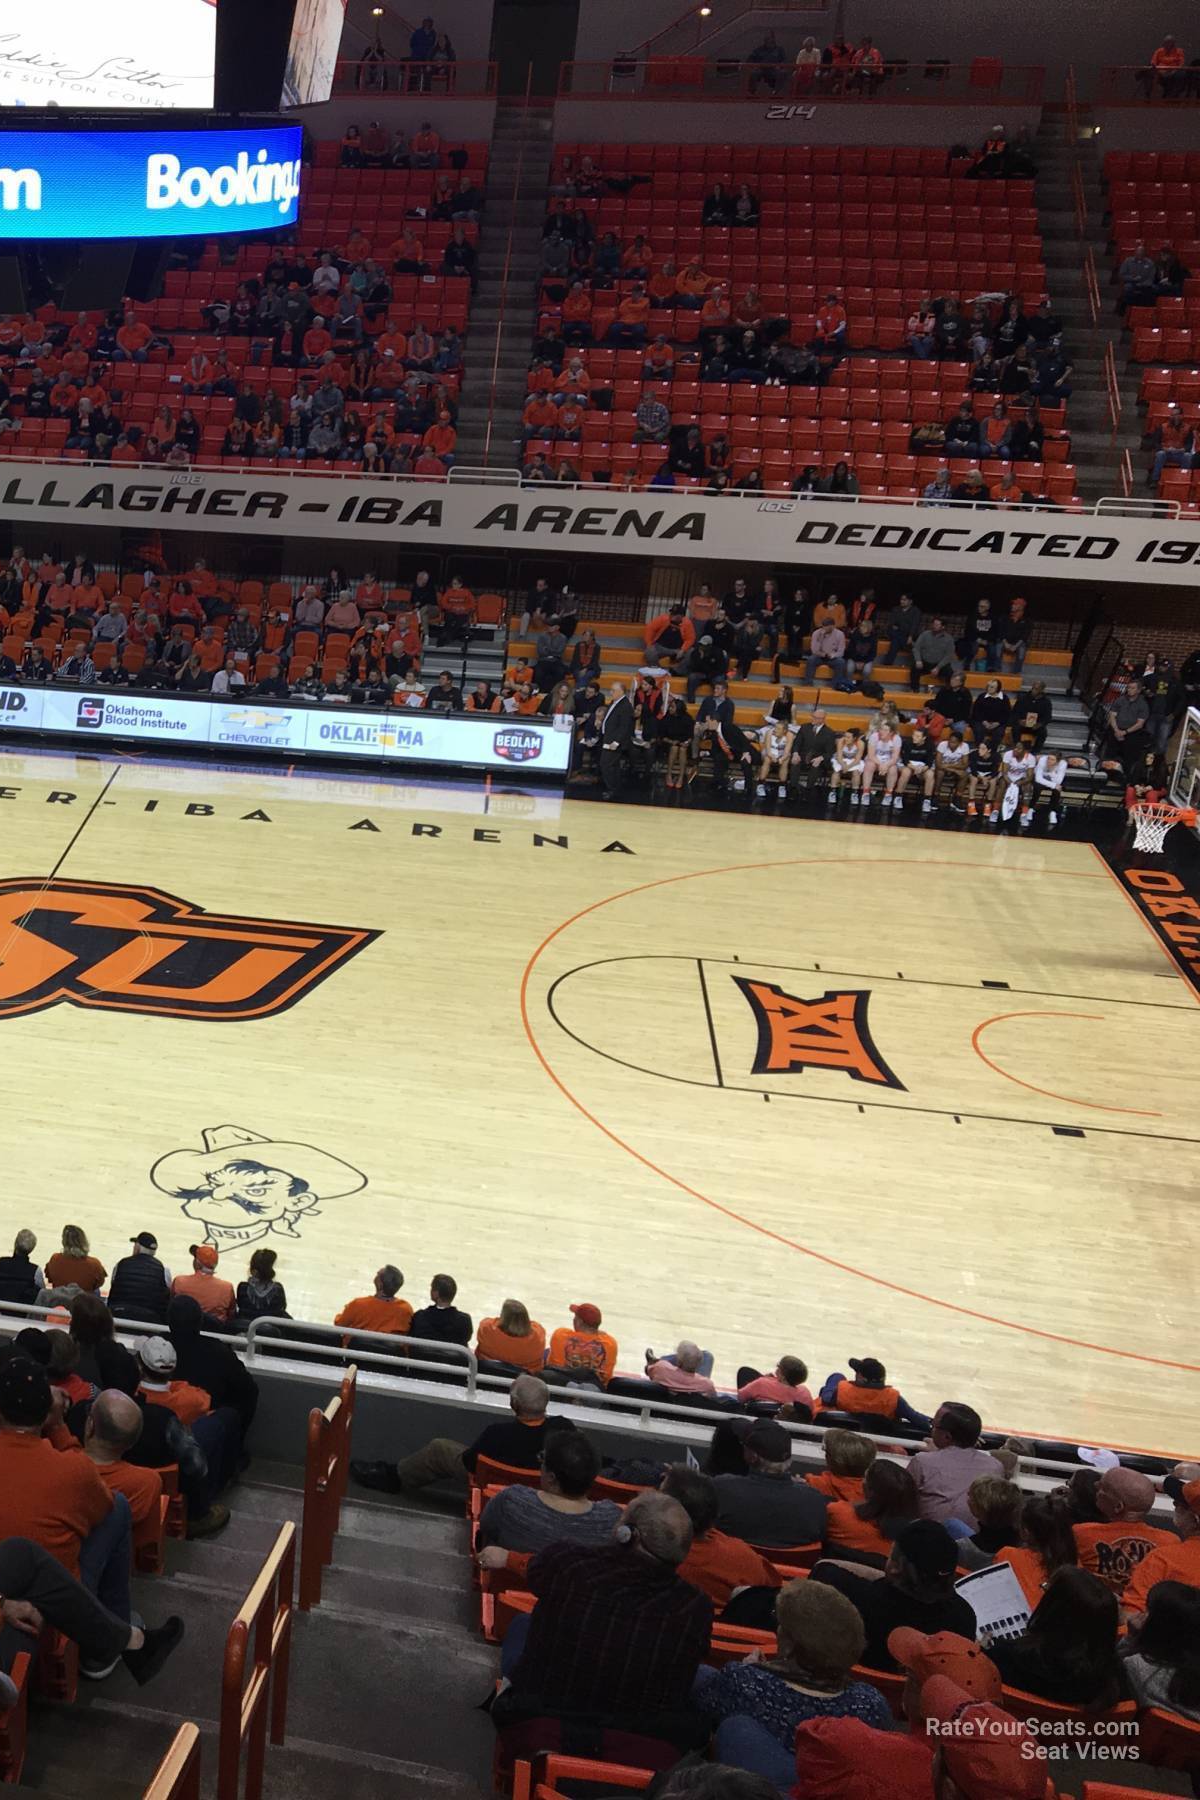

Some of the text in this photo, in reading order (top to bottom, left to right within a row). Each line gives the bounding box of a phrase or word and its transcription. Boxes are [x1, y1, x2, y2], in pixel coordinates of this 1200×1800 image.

[21, 74, 97, 94] SUTTON
[766, 105, 817, 119] 214
[170, 474, 204, 484] 108
[757, 501, 797, 513] 109
[474, 503, 706, 541] ARENA
[796, 521, 1200, 565] DEDICATED 19
[106, 704, 163, 718] Oklahoma
[105, 714, 187, 730] Blood Institute
[218, 732, 291, 746] CHEVROLET
[495, 734, 541, 749] BEDLAM
[346, 818, 637, 855] ARENA
[209, 1227, 251, 1240] OSU
